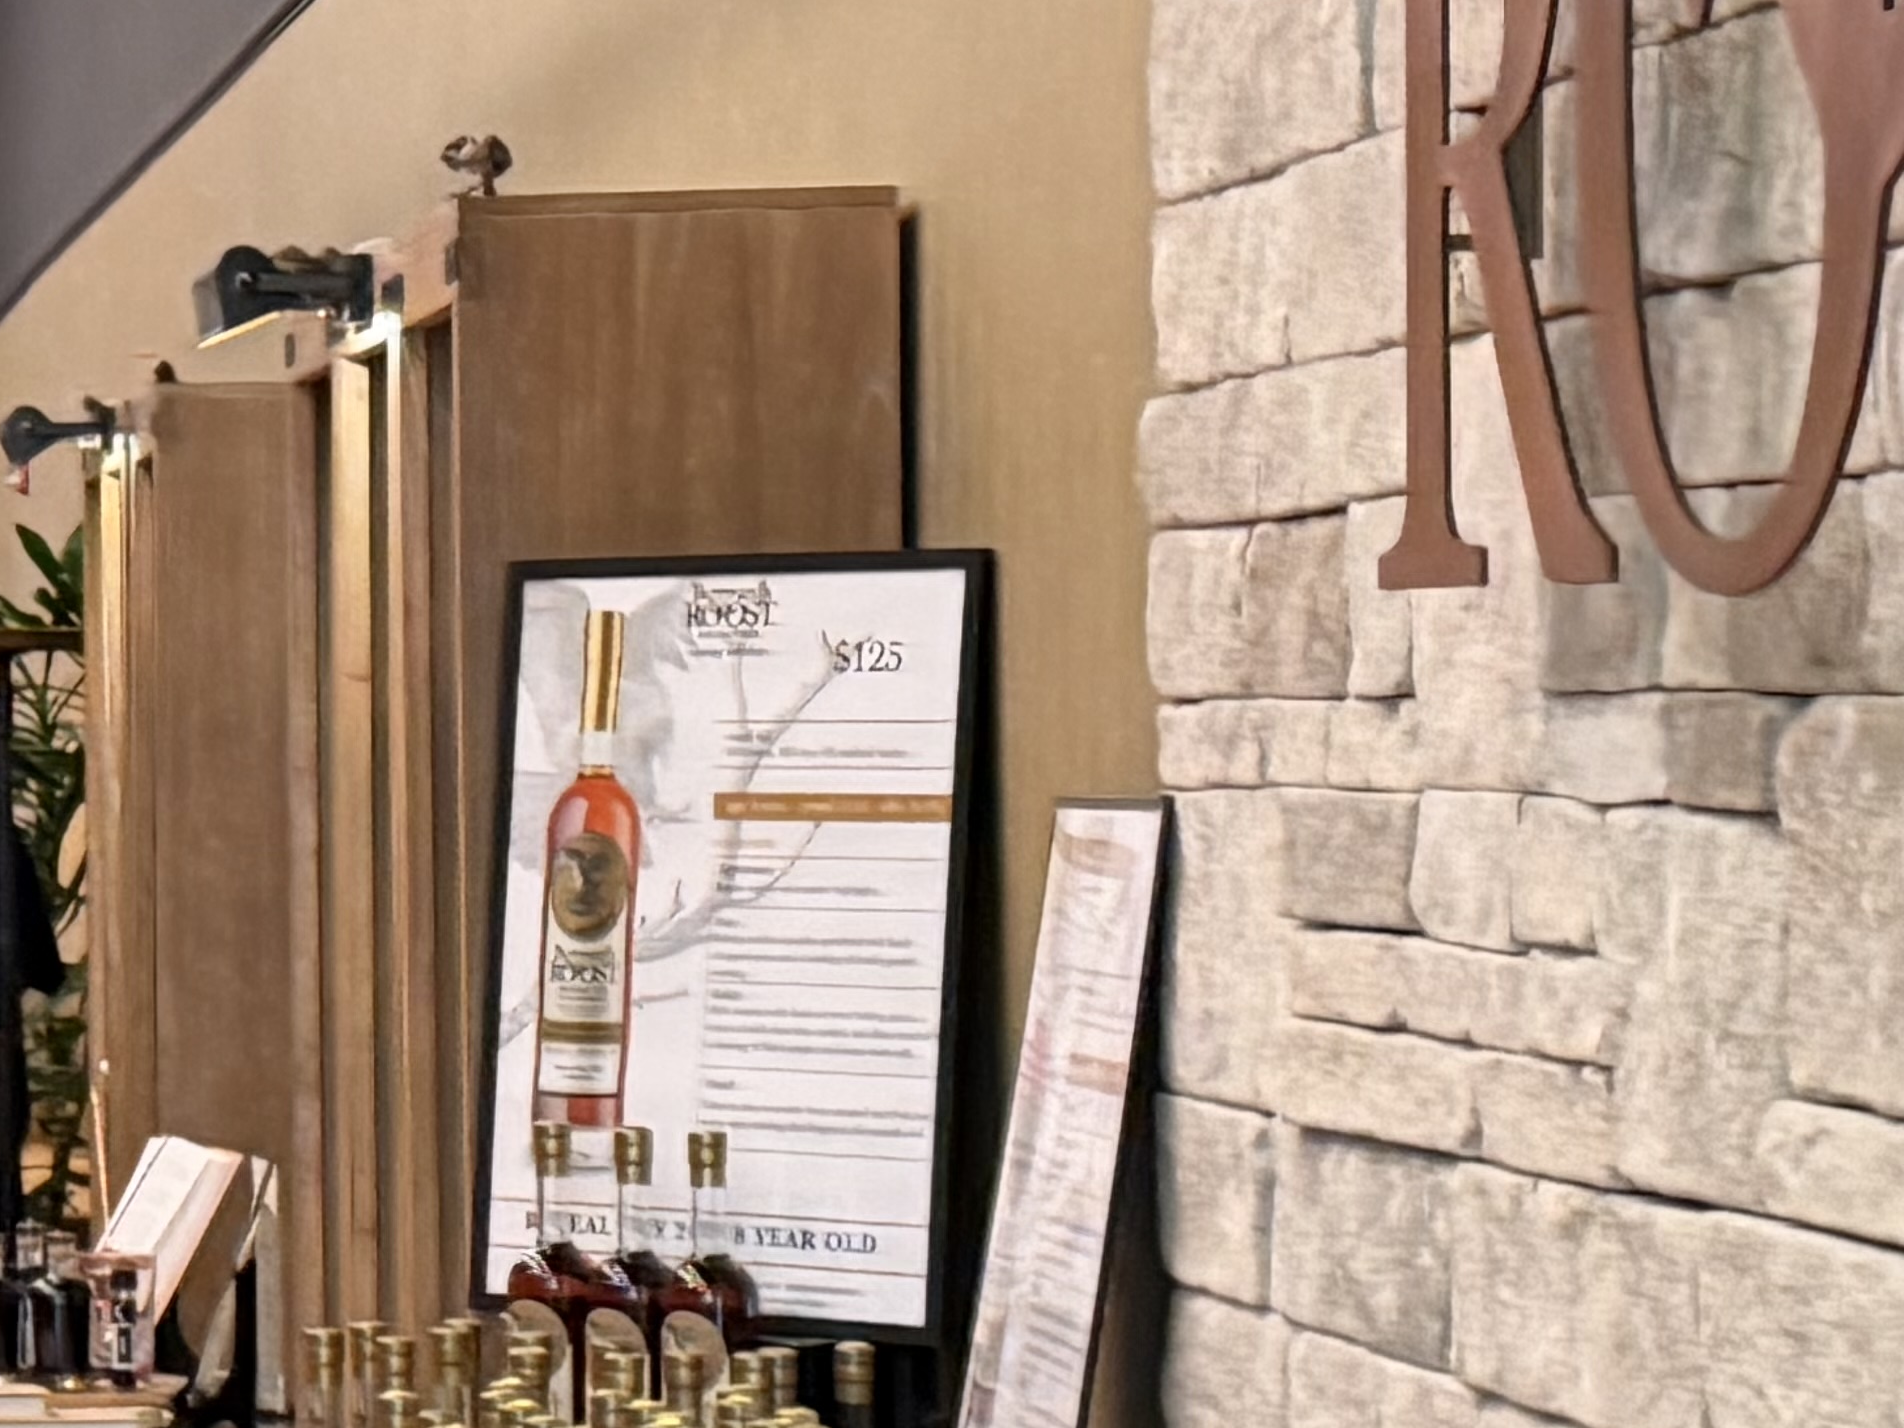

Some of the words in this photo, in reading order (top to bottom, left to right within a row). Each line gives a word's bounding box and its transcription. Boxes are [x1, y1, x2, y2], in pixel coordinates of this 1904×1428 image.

[833, 638, 905, 673] $125
[754, 1226, 816, 1252] YEAR
[824, 1233, 878, 1255] OLD
